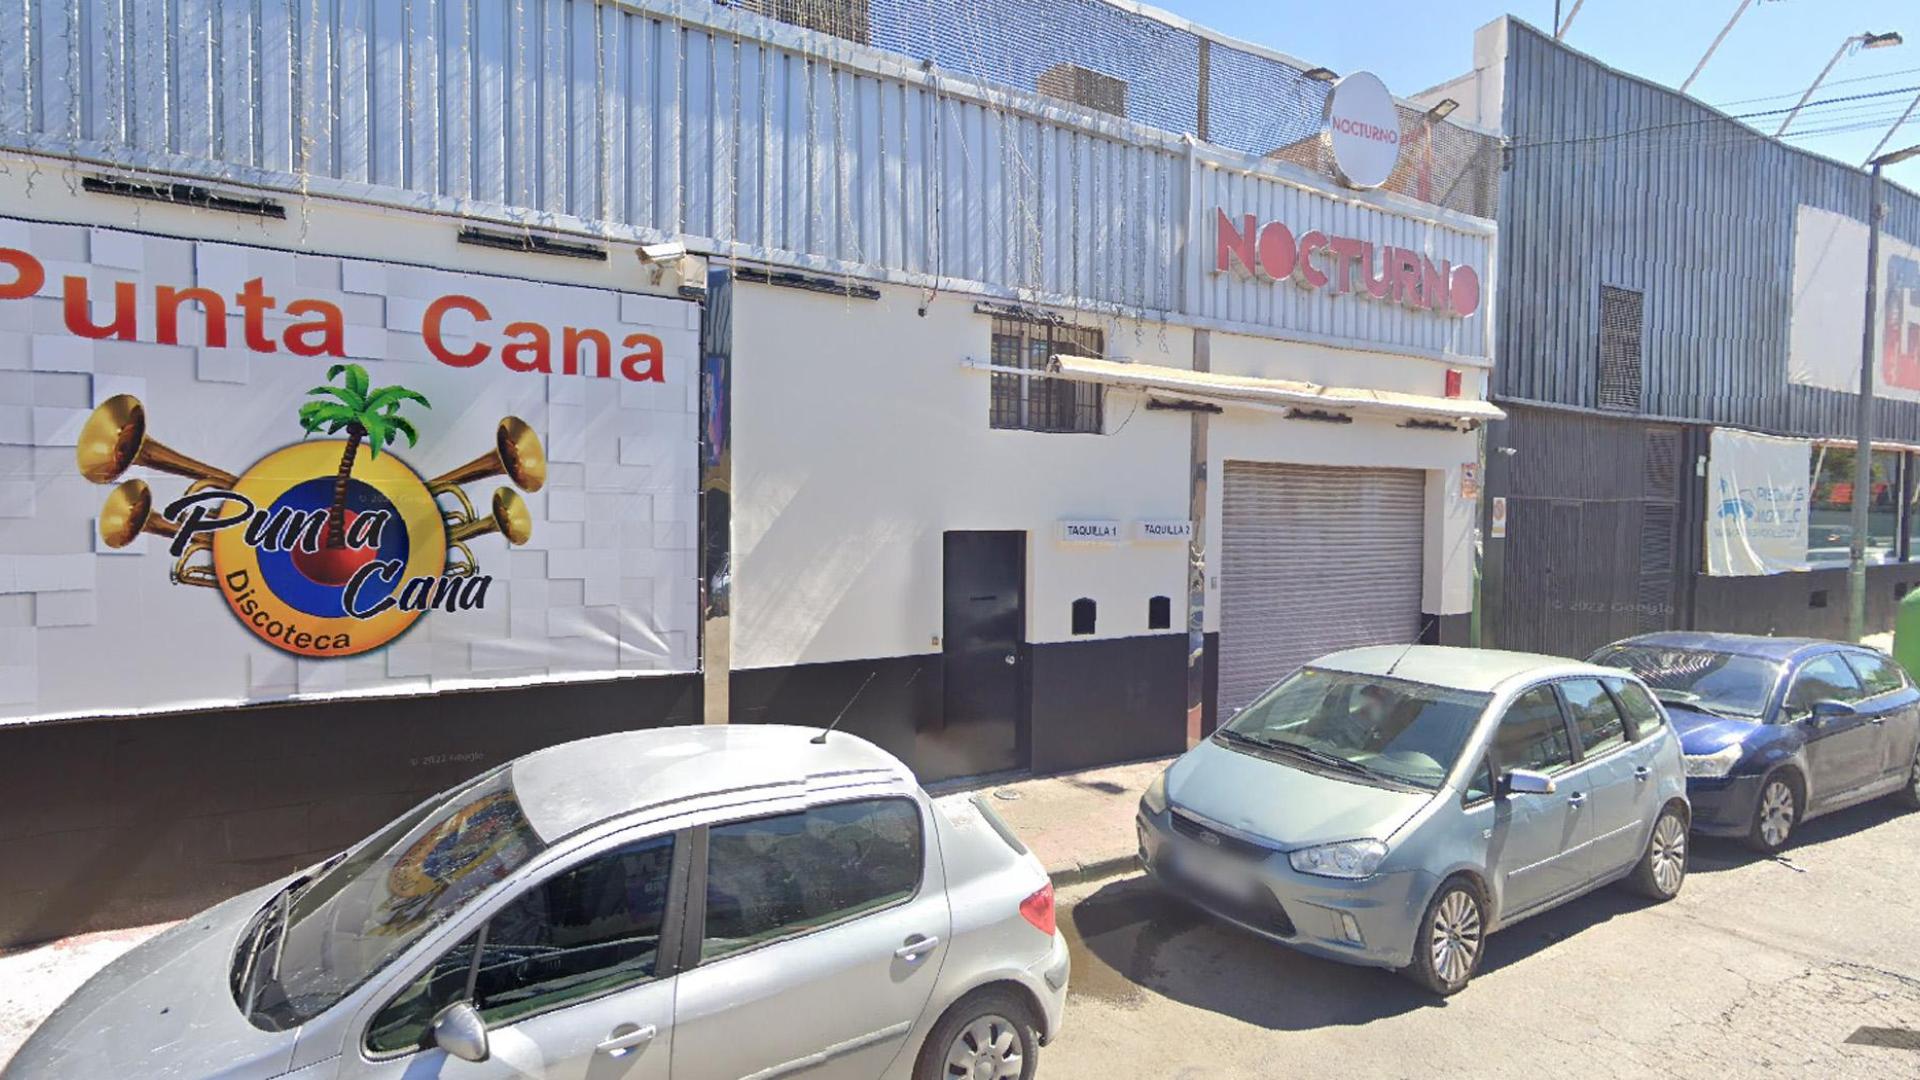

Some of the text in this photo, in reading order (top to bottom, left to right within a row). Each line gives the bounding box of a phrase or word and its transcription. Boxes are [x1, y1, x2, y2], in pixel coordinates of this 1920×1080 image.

[1332, 117, 1397, 145] NOCTURNO
[1216, 206, 1480, 318] NOCTURNO
[421, 294, 666, 383] Cana
[162, 491, 391, 557] Puna
[1067, 525, 1110, 536] TAQUILLA
[1144, 524, 1184, 536] TAQUILLA
[225, 568, 351, 650] Discoteca
[342, 559, 493, 620] Cana
